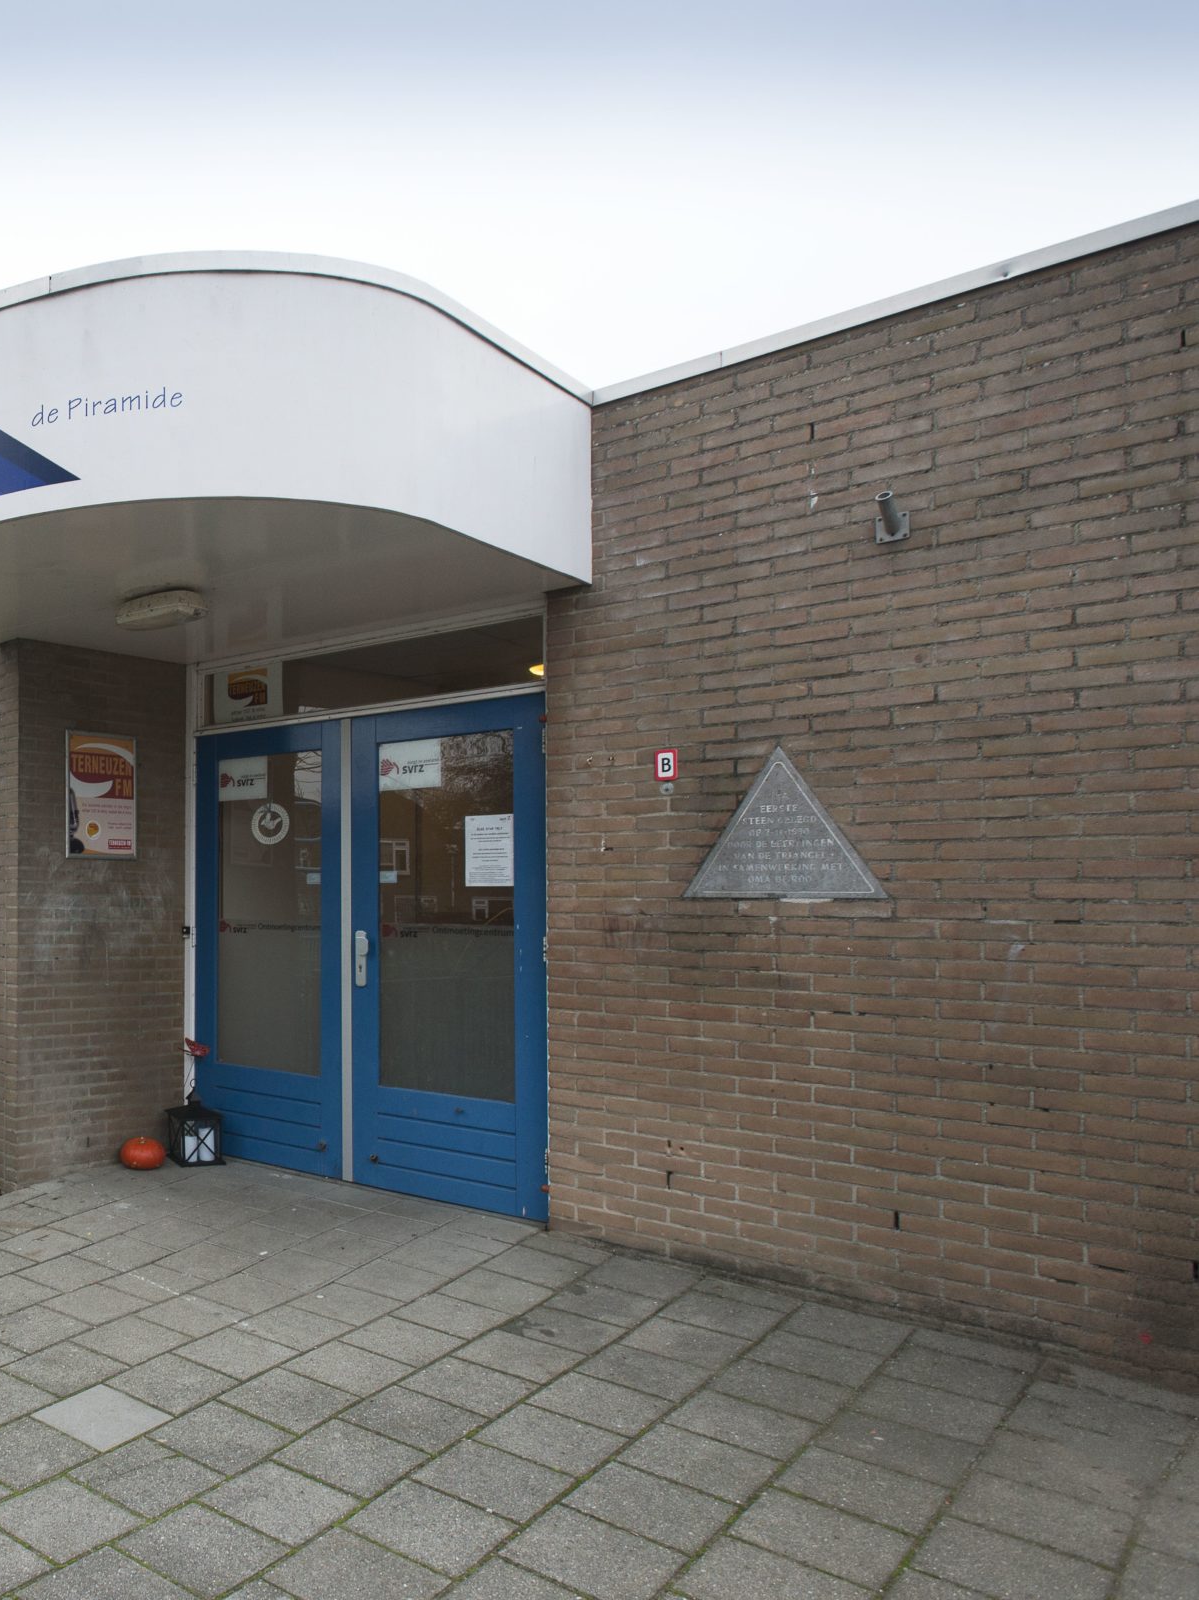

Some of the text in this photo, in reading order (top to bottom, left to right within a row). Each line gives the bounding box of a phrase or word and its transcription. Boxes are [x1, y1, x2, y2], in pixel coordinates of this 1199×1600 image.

[31, 386, 183, 427] de Piramide
[71, 754, 132, 776] TERNEUZEN
[661, 757, 672, 773] B
[115, 779, 133, 797] FM
[759, 804, 799, 813] EERSTE
[742, 816, 774, 825] STEEN
[756, 840, 768, 848] DE
[758, 852, 771, 860] DE
[820, 863, 843, 871] MET
